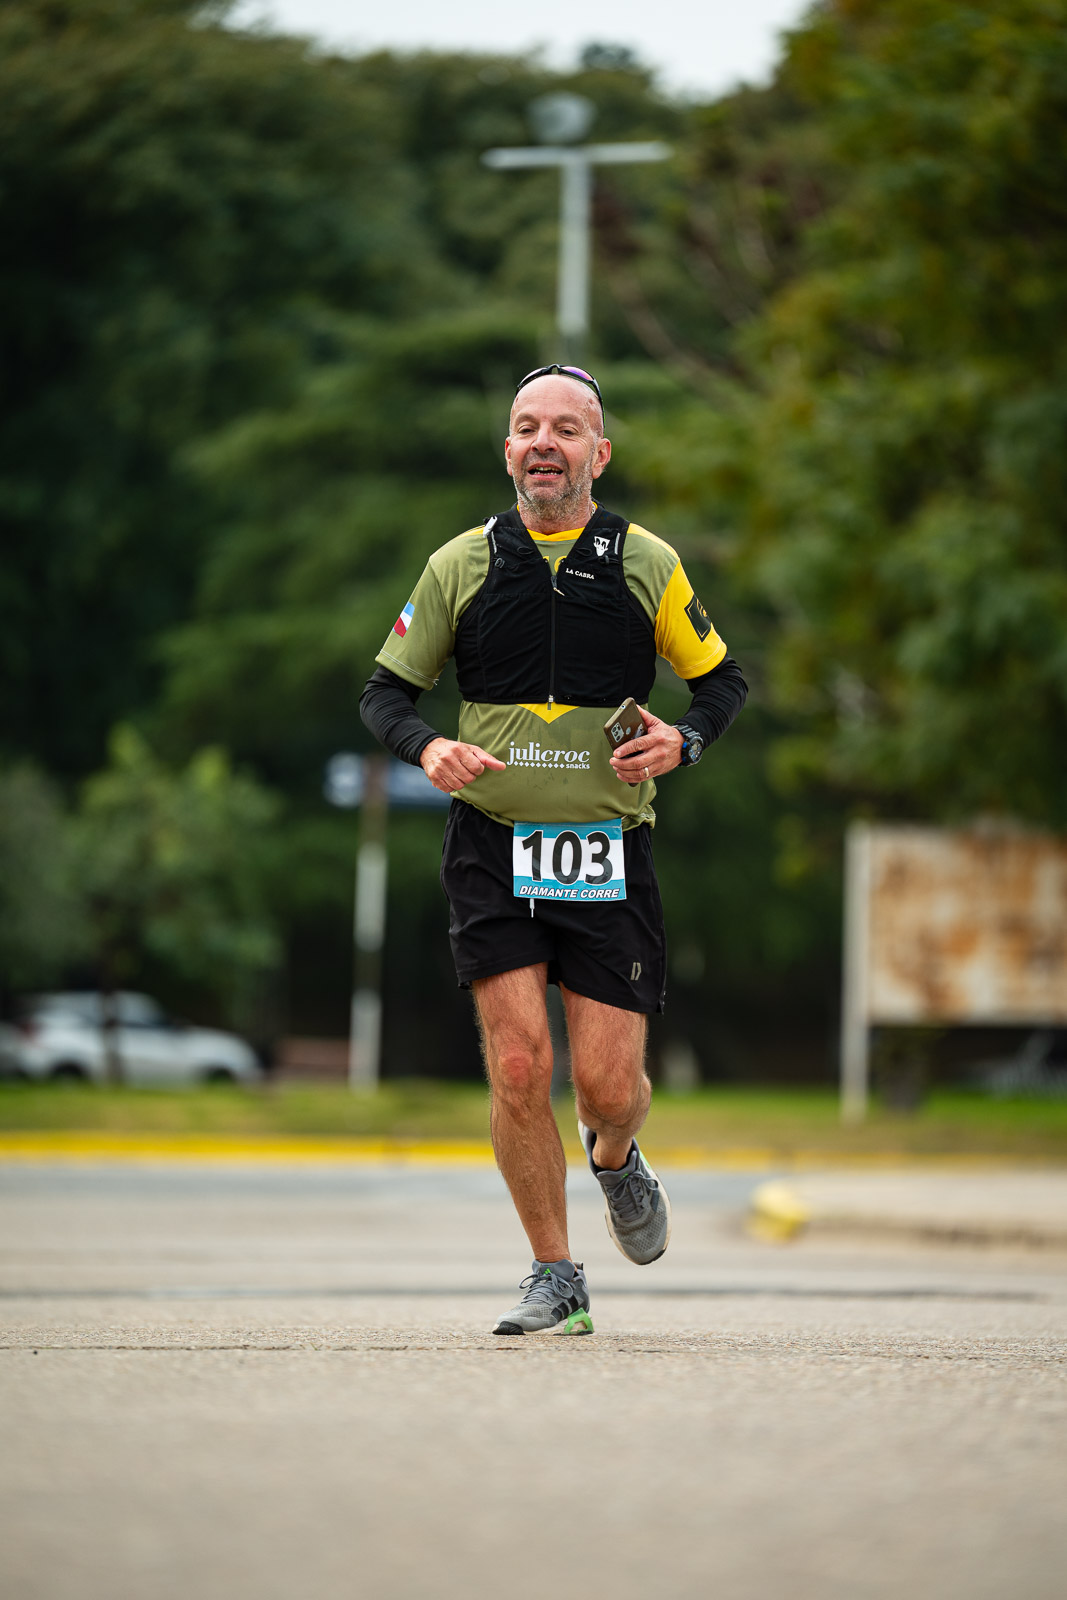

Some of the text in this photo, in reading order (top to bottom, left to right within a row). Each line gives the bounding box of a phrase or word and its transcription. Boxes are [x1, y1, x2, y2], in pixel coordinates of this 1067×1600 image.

[575, 570, 595, 579] CABRA
[506, 741, 591, 766] julicroc
[565, 762, 591, 770] snacks
[521, 829, 614, 886] 103
[519, 885, 620, 899] DIAMANTE CORRE
